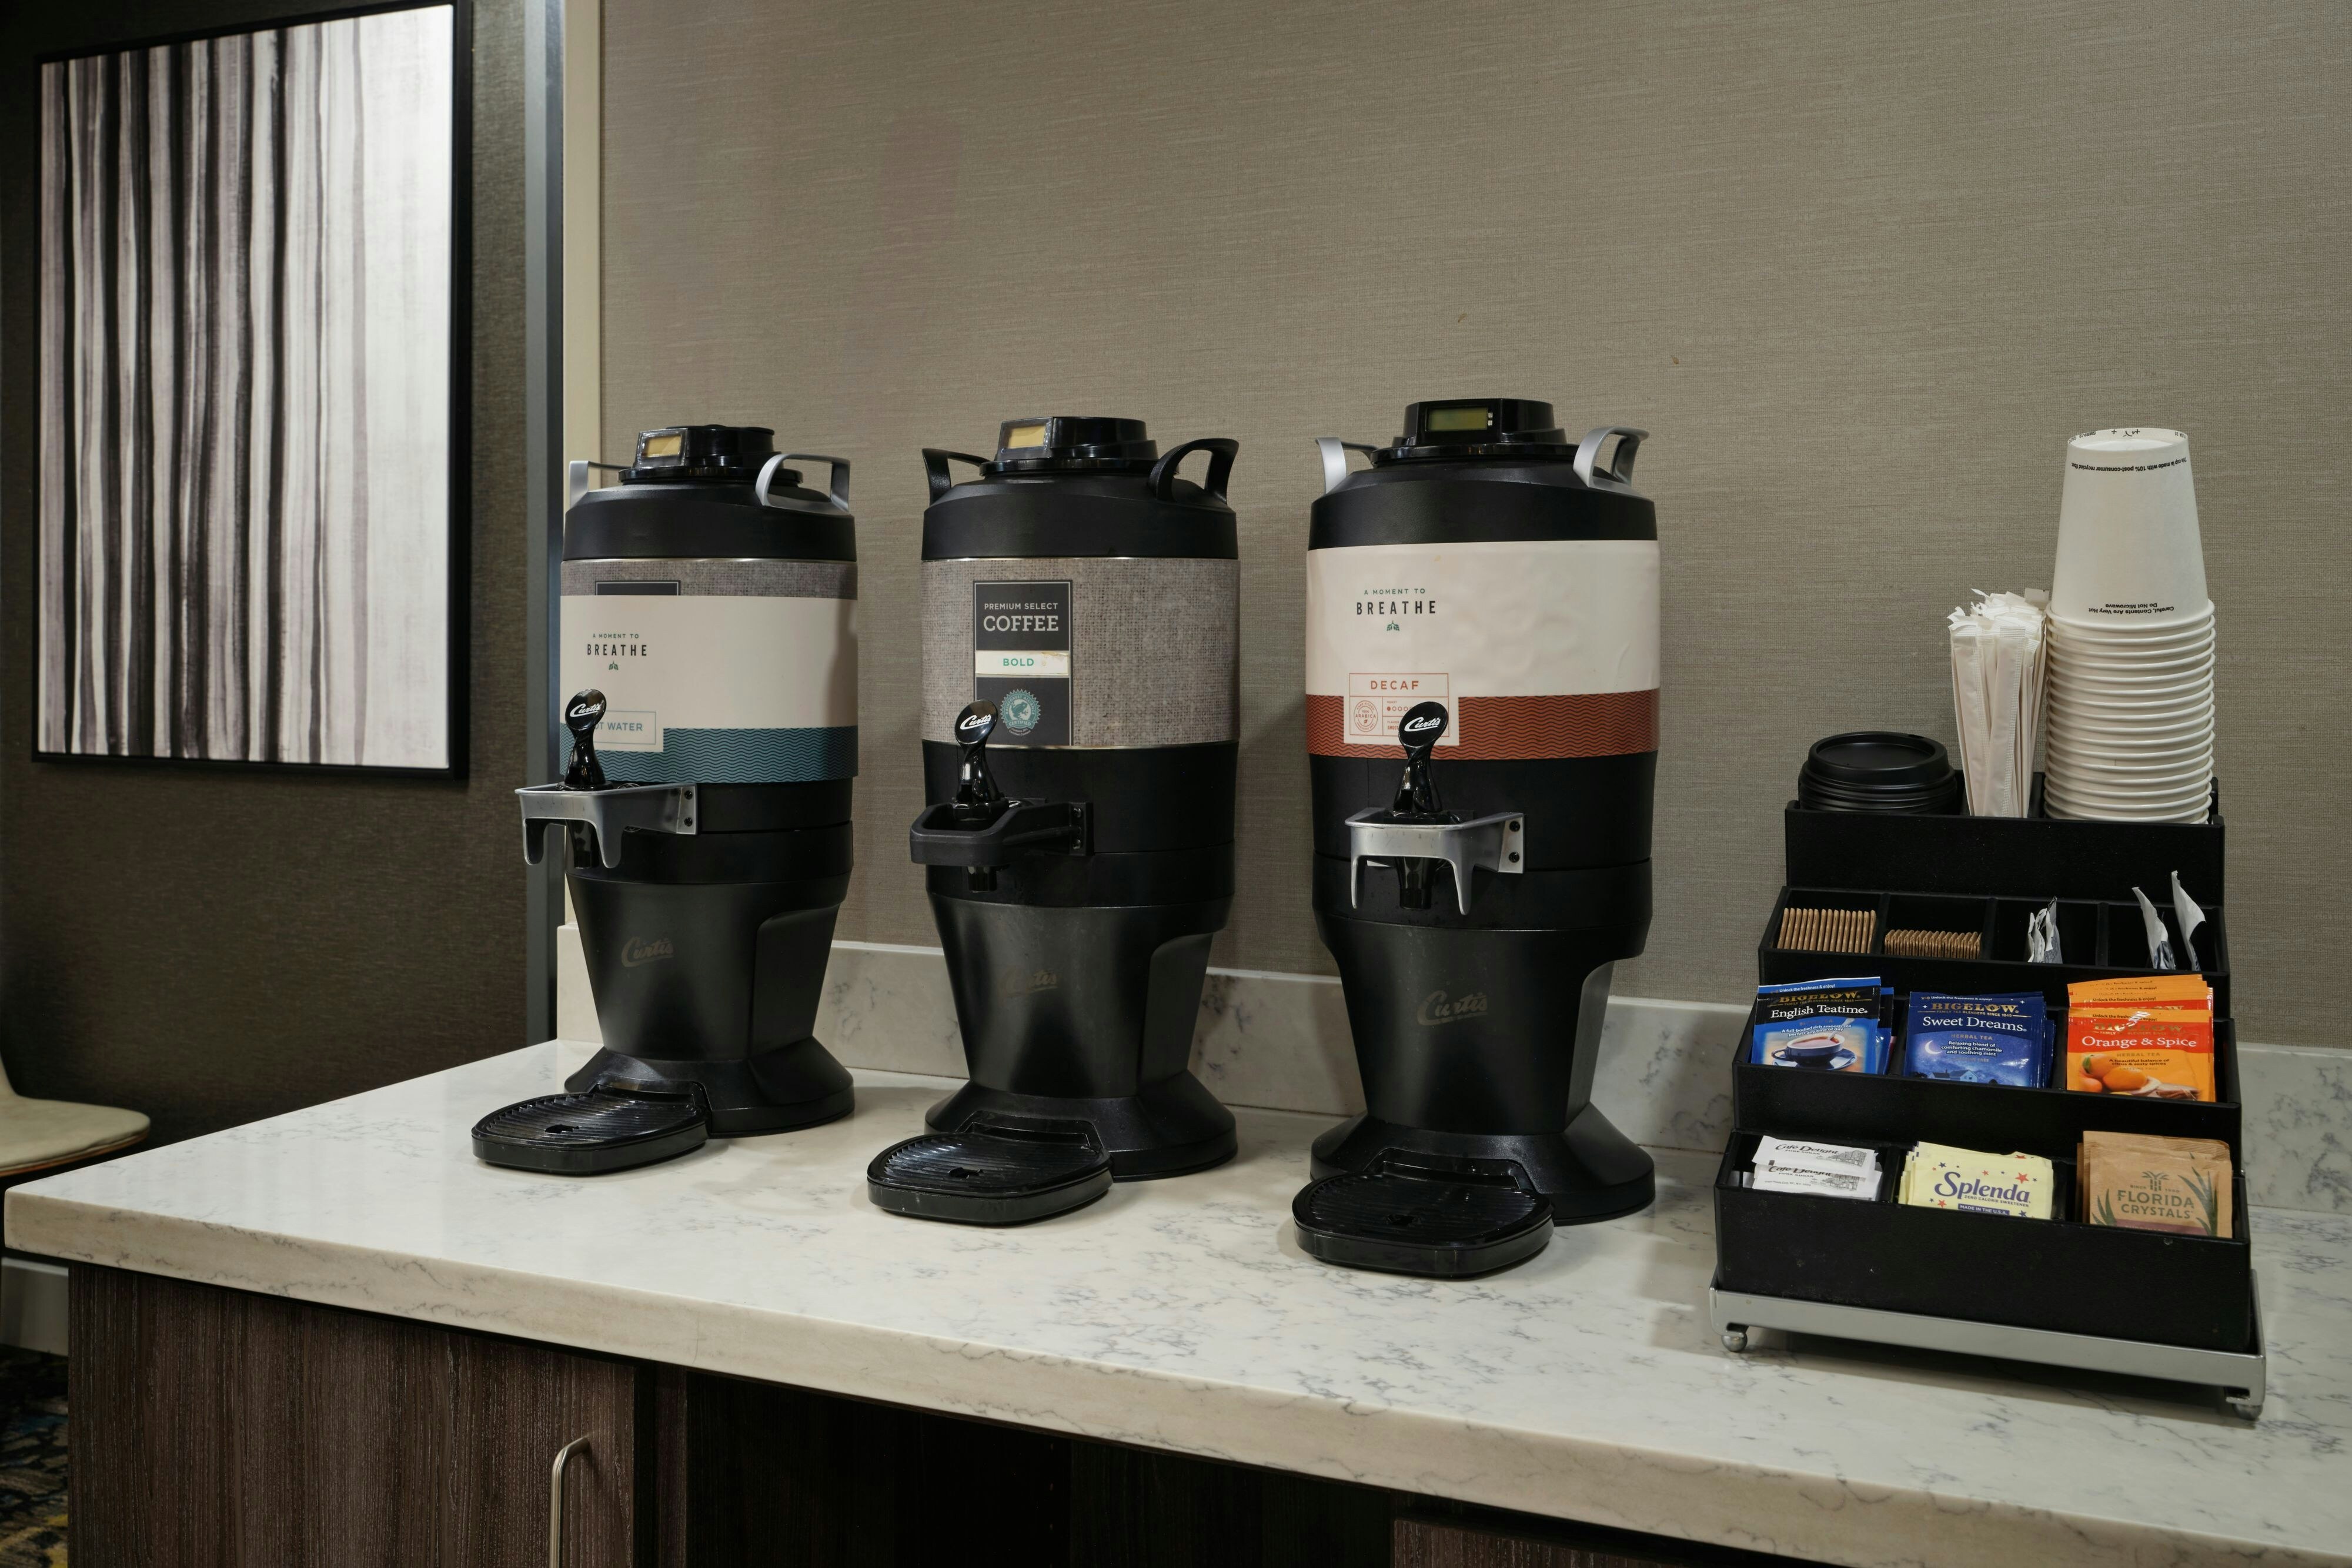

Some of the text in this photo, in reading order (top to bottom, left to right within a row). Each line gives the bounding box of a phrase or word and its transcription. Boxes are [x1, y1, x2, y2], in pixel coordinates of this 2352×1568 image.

[1357, 600, 1436, 615] BREATHE
[983, 615, 1058, 632] COFFEE
[587, 644, 647, 656] BREATHE
[1003, 658, 1035, 666] BOLD
[1371, 680, 1419, 690] DECAF
[607, 722, 643, 731] WATER
[960, 714, 992, 730] Curtis
[1404, 717, 1441, 732] Curtis
[621, 936, 674, 968] Curtis
[1416, 990, 1488, 1026] Curtis
[1770, 1006, 1814, 1019] English
[1931, 1002, 2019, 1013] BIGELOW
[1922, 1016, 1963, 1027] Sweet
[2082, 1036, 2197, 1049] Orange & Spice
[1799, 1146, 1839, 1154] Delight
[1934, 1171, 2030, 1203] Splenda
[2117, 1189, 2194, 1209] FLORIDA
[2121, 1203, 2190, 1219] CRYSTALS
